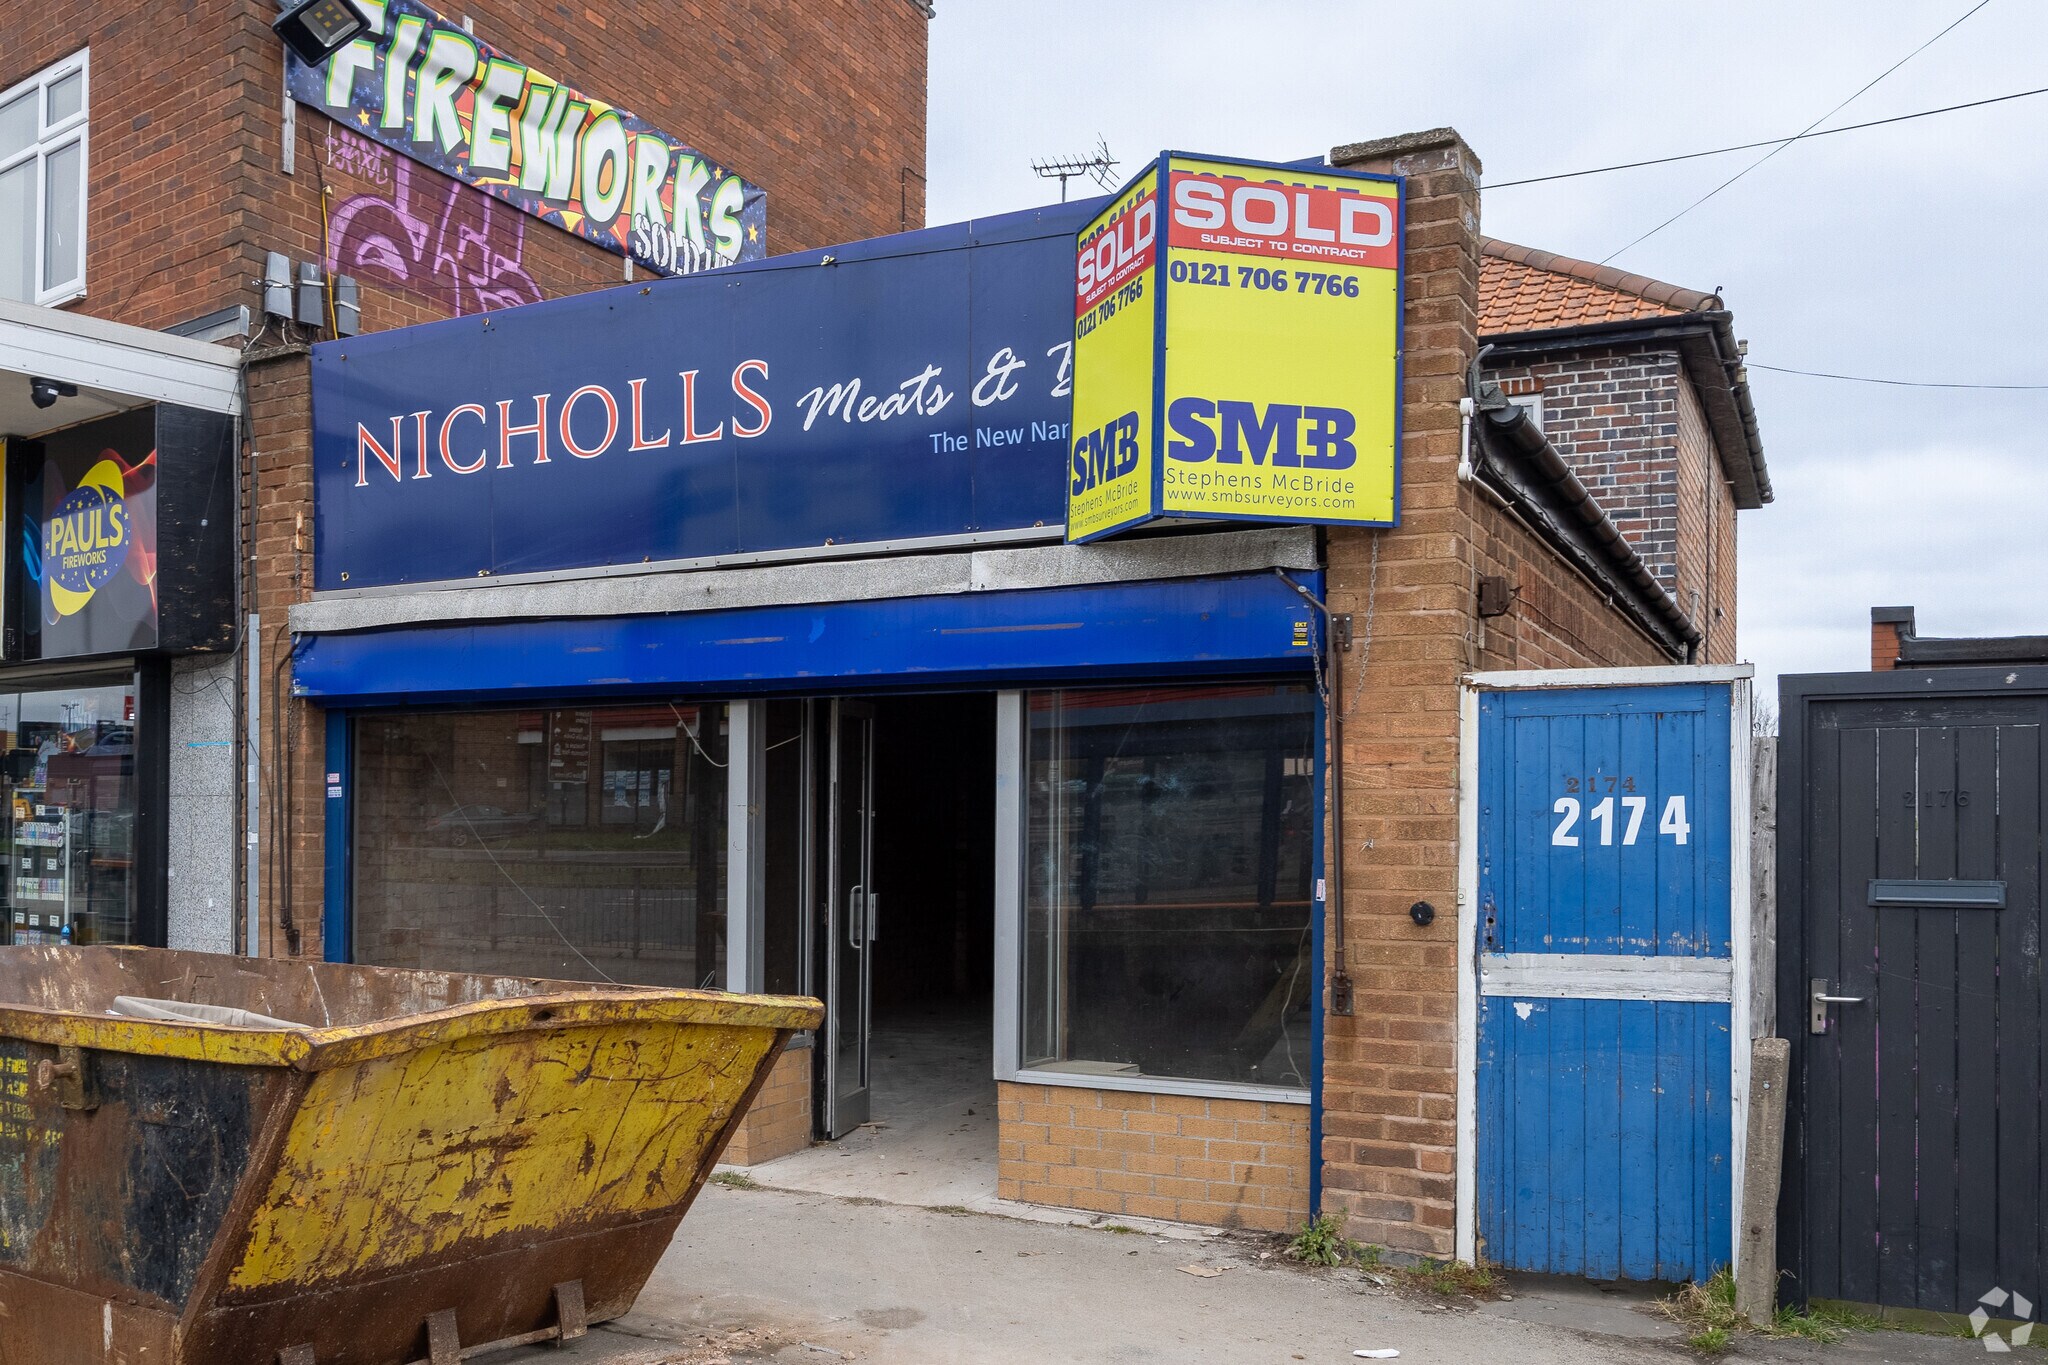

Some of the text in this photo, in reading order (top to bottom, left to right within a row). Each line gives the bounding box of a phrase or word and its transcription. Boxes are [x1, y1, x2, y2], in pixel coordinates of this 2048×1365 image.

[326, 0, 744, 262] FIREWORKS
[1174, 179, 1393, 247] SOLD
[1077, 199, 1156, 296] SOLD
[1200, 233, 1367, 259] SUBJECT TO CONTRACT
[1085, 254, 1145, 304] SUBJECT TO CONTRACT
[1170, 260, 1359, 298] 0121 706 7766
[1077, 275, 1143, 340] 0121 706 7766
[354, 358, 773, 488] NICHOLLS
[796, 363, 954, 431] Meats
[971, 347, 1026, 407] &
[1168, 396, 1357, 470] SMB
[929, 431, 968, 454] The
[976, 426, 1024, 449] New
[1072, 410, 1139, 496] SMB
[1070, 480, 1138, 518] Stephens McBride
[1166, 467, 1355, 494] Stephens McBride
[1167, 489, 1355, 509] www.smbsurveyors.com
[50, 503, 124, 557] PAULS
[1070, 498, 1138, 531] www.smbsurveyors.com
[62, 550, 107, 570] FIREWORKS
[1566, 776, 1636, 793] 2174
[1902, 789, 1970, 808] 2176
[1551, 795, 1690, 847] 2174
